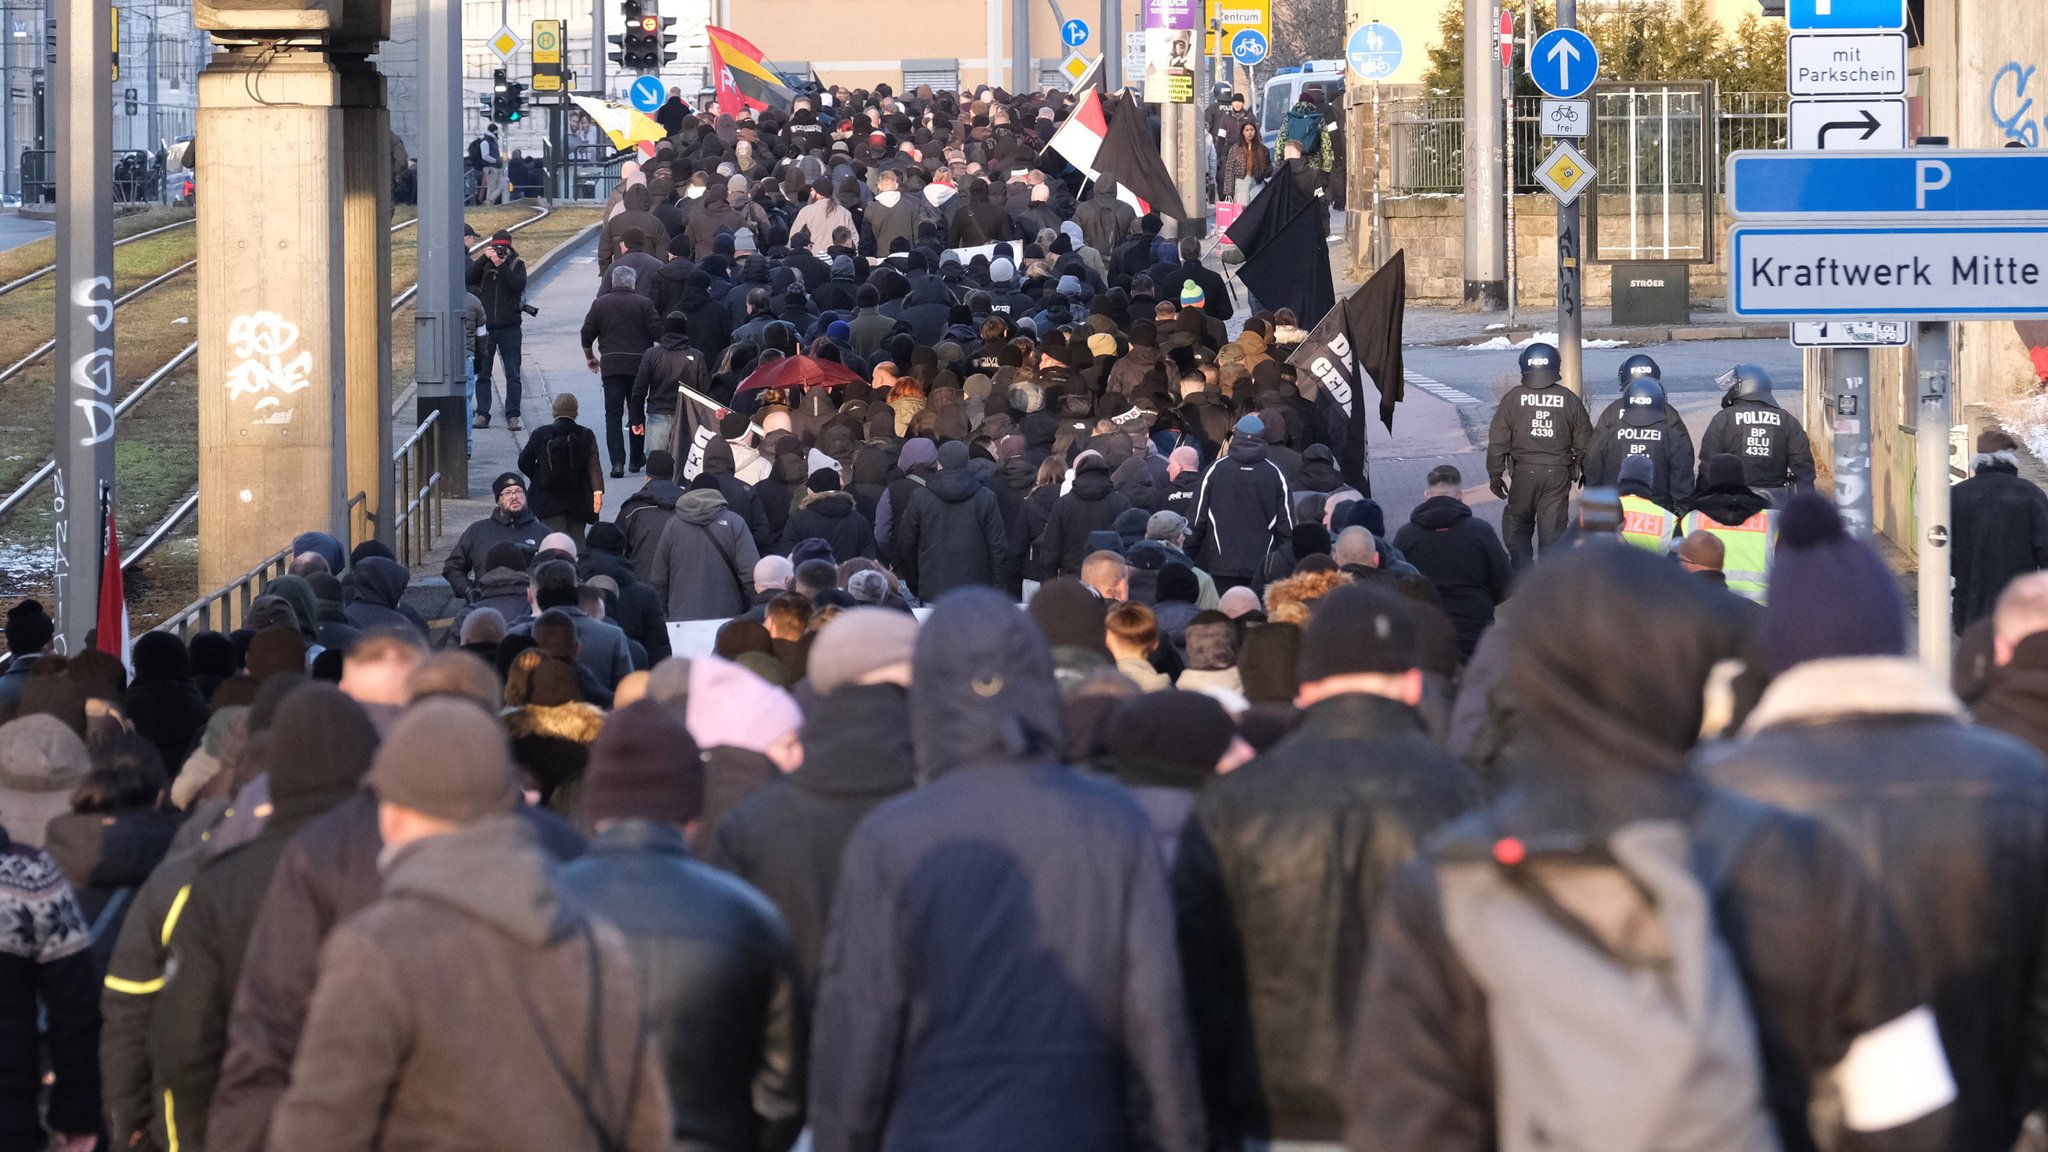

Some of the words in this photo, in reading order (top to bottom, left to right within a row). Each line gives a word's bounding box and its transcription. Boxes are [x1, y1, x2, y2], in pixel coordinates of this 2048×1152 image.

[1833, 47, 1861, 62] mit
[1799, 66, 1895, 82] Parkschein
[1557, 123, 1573, 132] frei
[1915, 159, 1952, 210] P
[1751, 256, 1932, 287] Kraftwerk
[1952, 255, 2040, 285] Mitte
[1527, 358, 1549, 366] F430
[1630, 366, 1652, 375] F430
[1520, 394, 1564, 408] POLIZEI
[1629, 396, 1652, 405] F430
[1535, 410, 1550, 420] BP
[1735, 411, 1781, 426] POLIZEI
[1531, 419, 1553, 429] BLU
[1530, 428, 1554, 437] 4330
[1617, 428, 1661, 441] POLIZEI
[1751, 428, 1767, 437] BP
[1747, 437, 1770, 447] BLU
[1630, 444, 1646, 454] BP
[1745, 446, 1770, 456] 4332
[1624, 511, 1661, 535] IZEI
